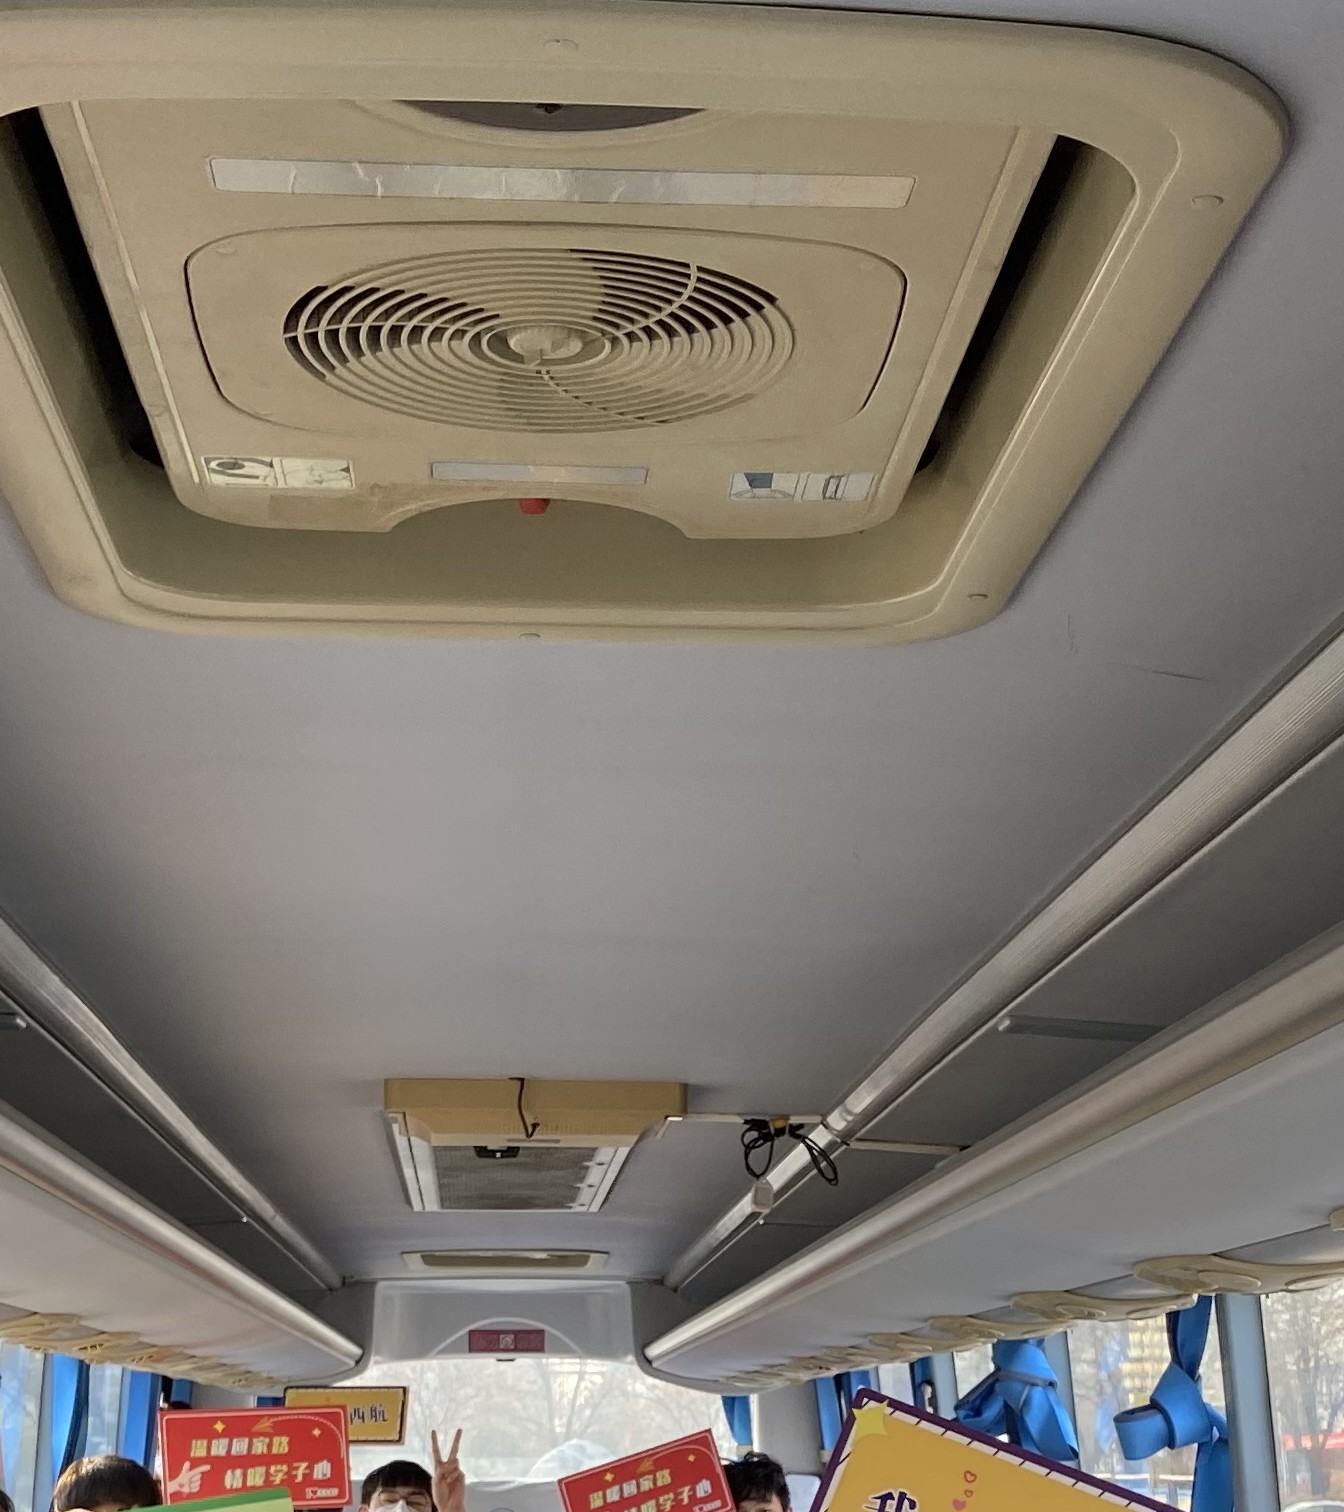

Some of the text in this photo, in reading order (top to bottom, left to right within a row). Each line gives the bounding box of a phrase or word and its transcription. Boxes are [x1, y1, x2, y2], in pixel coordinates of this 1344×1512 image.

[190, 1435, 290, 1459] 温暖回家路
[224, 1460, 332, 1490] 情暖学子心
[588, 1468, 672, 1509] 温暖回家路
